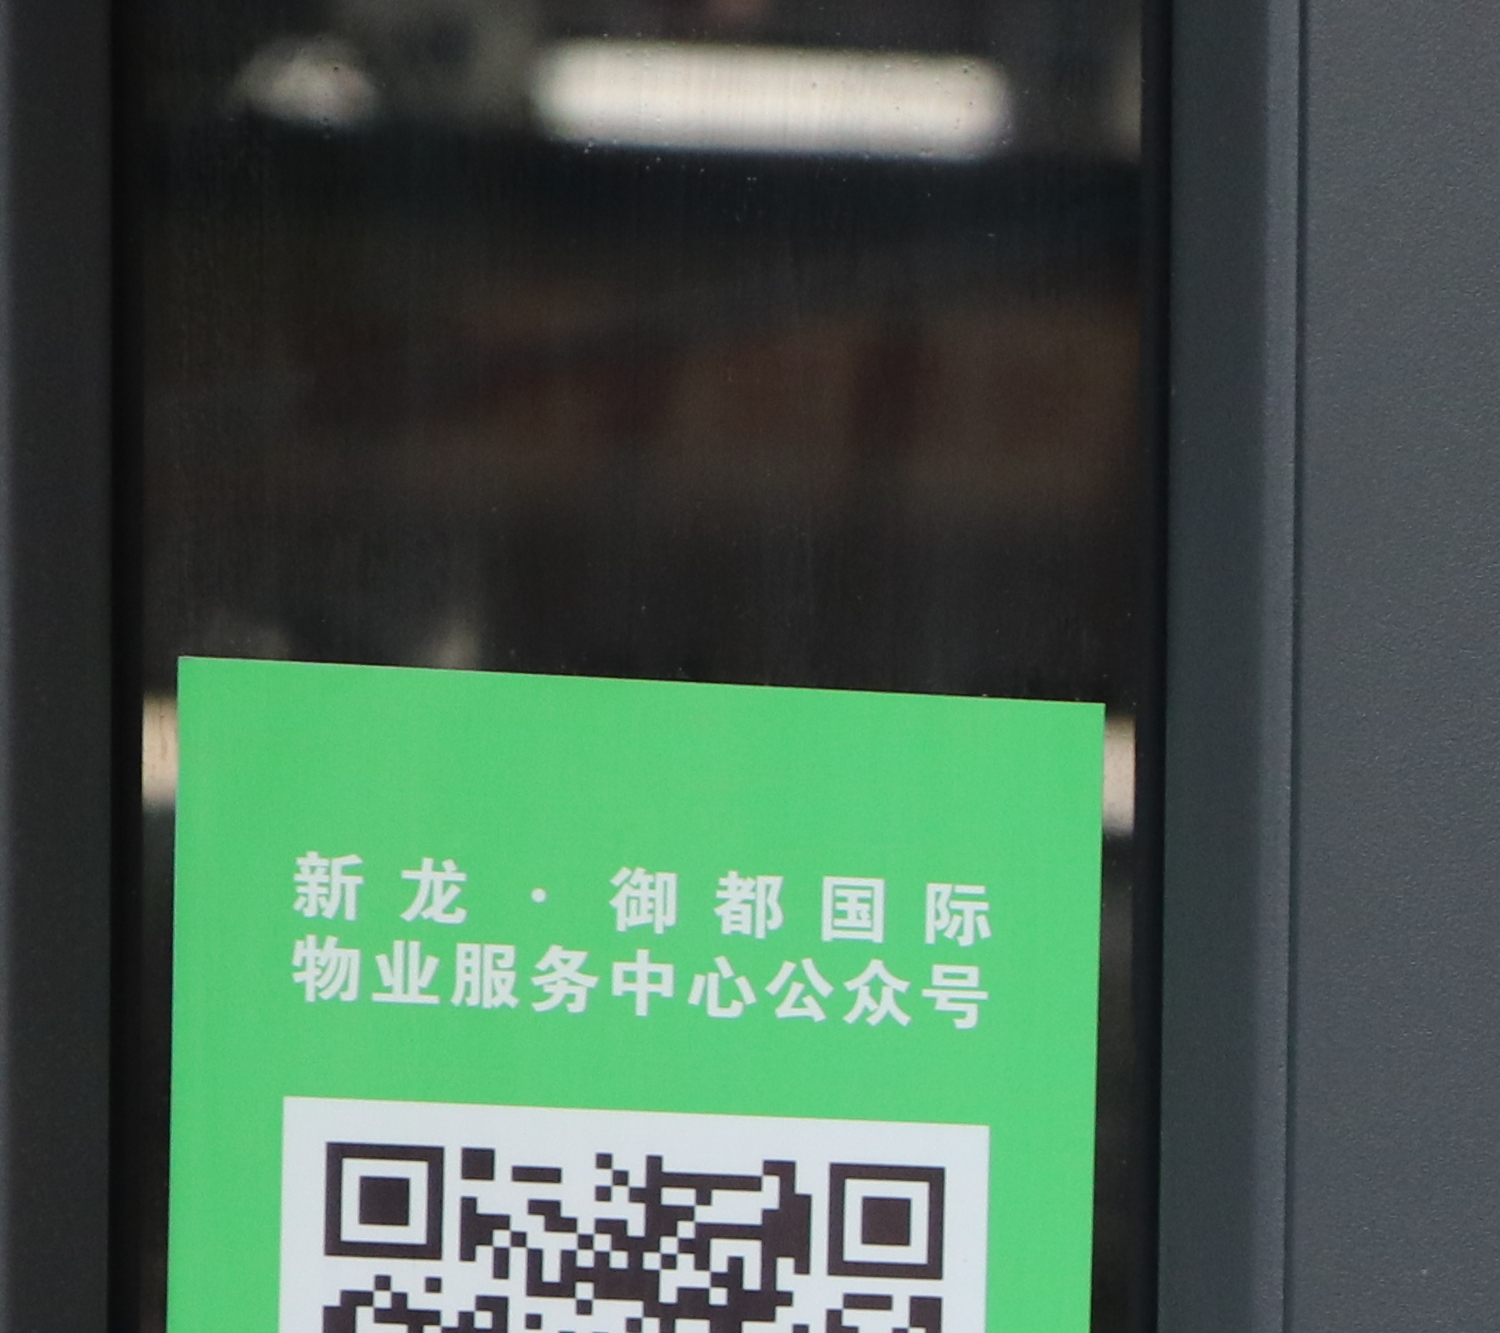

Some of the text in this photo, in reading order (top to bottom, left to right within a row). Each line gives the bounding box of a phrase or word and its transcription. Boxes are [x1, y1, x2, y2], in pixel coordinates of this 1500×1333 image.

[292, 936, 990, 1029] 物业服务中心公众号
